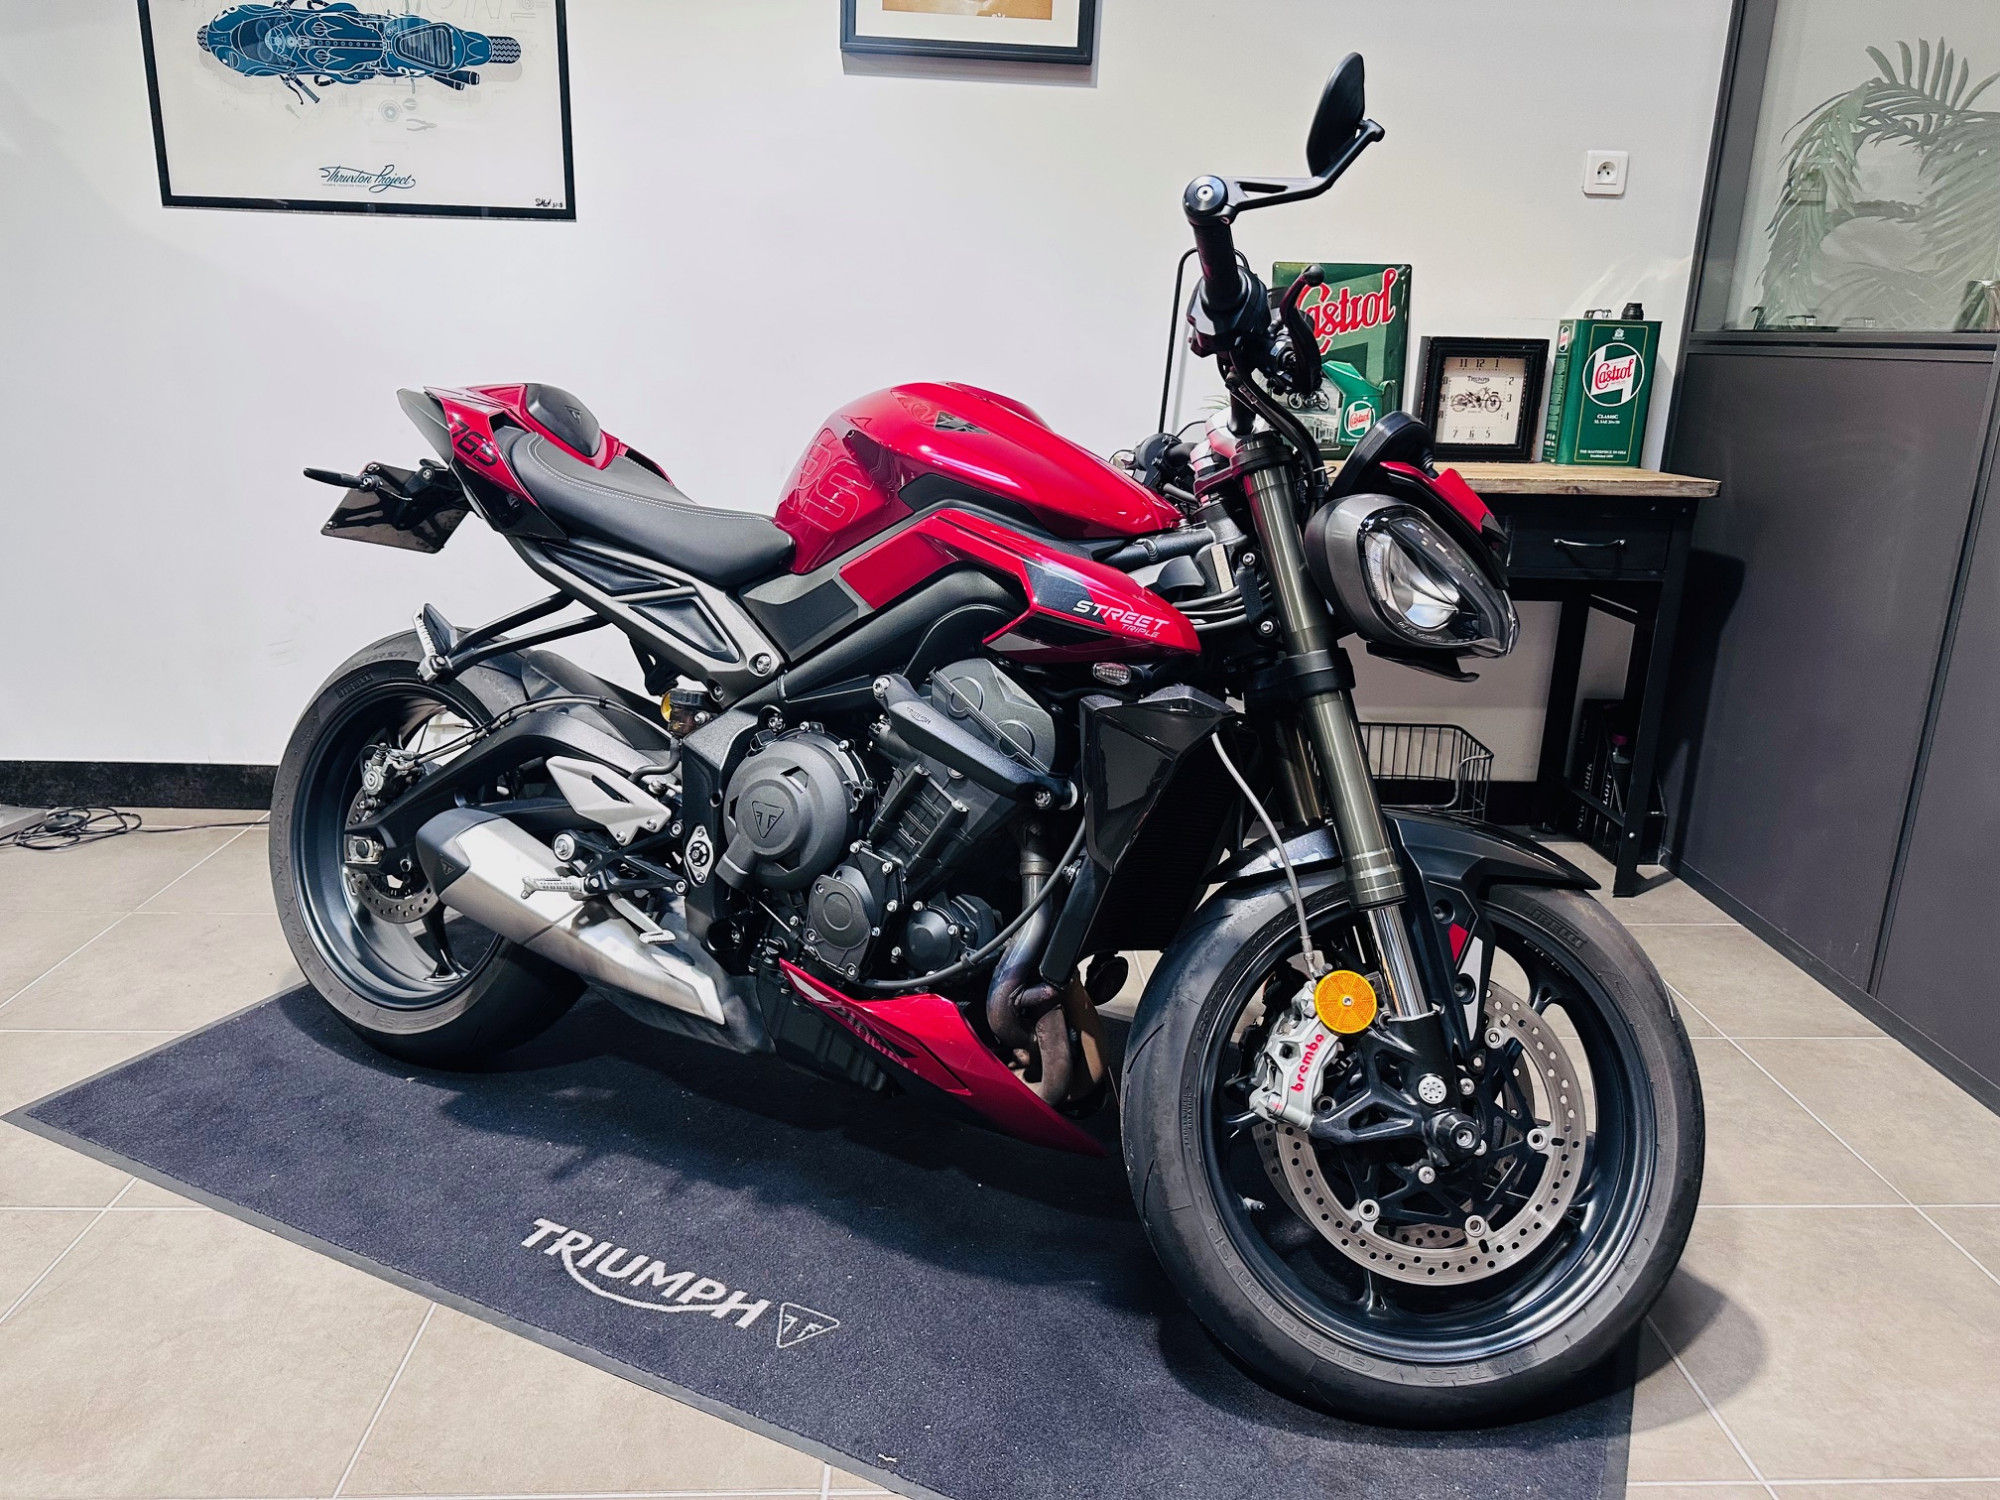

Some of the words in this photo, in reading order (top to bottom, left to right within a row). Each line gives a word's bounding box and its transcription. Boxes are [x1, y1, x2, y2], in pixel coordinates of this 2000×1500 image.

[319, 165, 372, 184] Thruxton
[369, 164, 416, 193] Project
[1460, 359, 1468, 367] 11
[1476, 359, 1485, 367] 12
[1495, 359, 1499, 367] 1
[1508, 376, 1515, 386] 2
[1595, 358, 1634, 390] Castrol
[1506, 394, 1512, 402] 3
[1350, 410, 1371, 429] Castrol
[1453, 429, 1458, 438] 7
[1469, 429, 1475, 438] 6
[1485, 429, 1491, 438] 5
[1072, 599, 1170, 631] STREET
[1121, 623, 1160, 638] TRIPLE
[1584, 763, 1593, 790] ORK
[1602, 772, 1612, 805] LOFT
[1290, 1033, 1325, 1093] brembo
[521, 1217, 771, 1329] TRIUMPH
